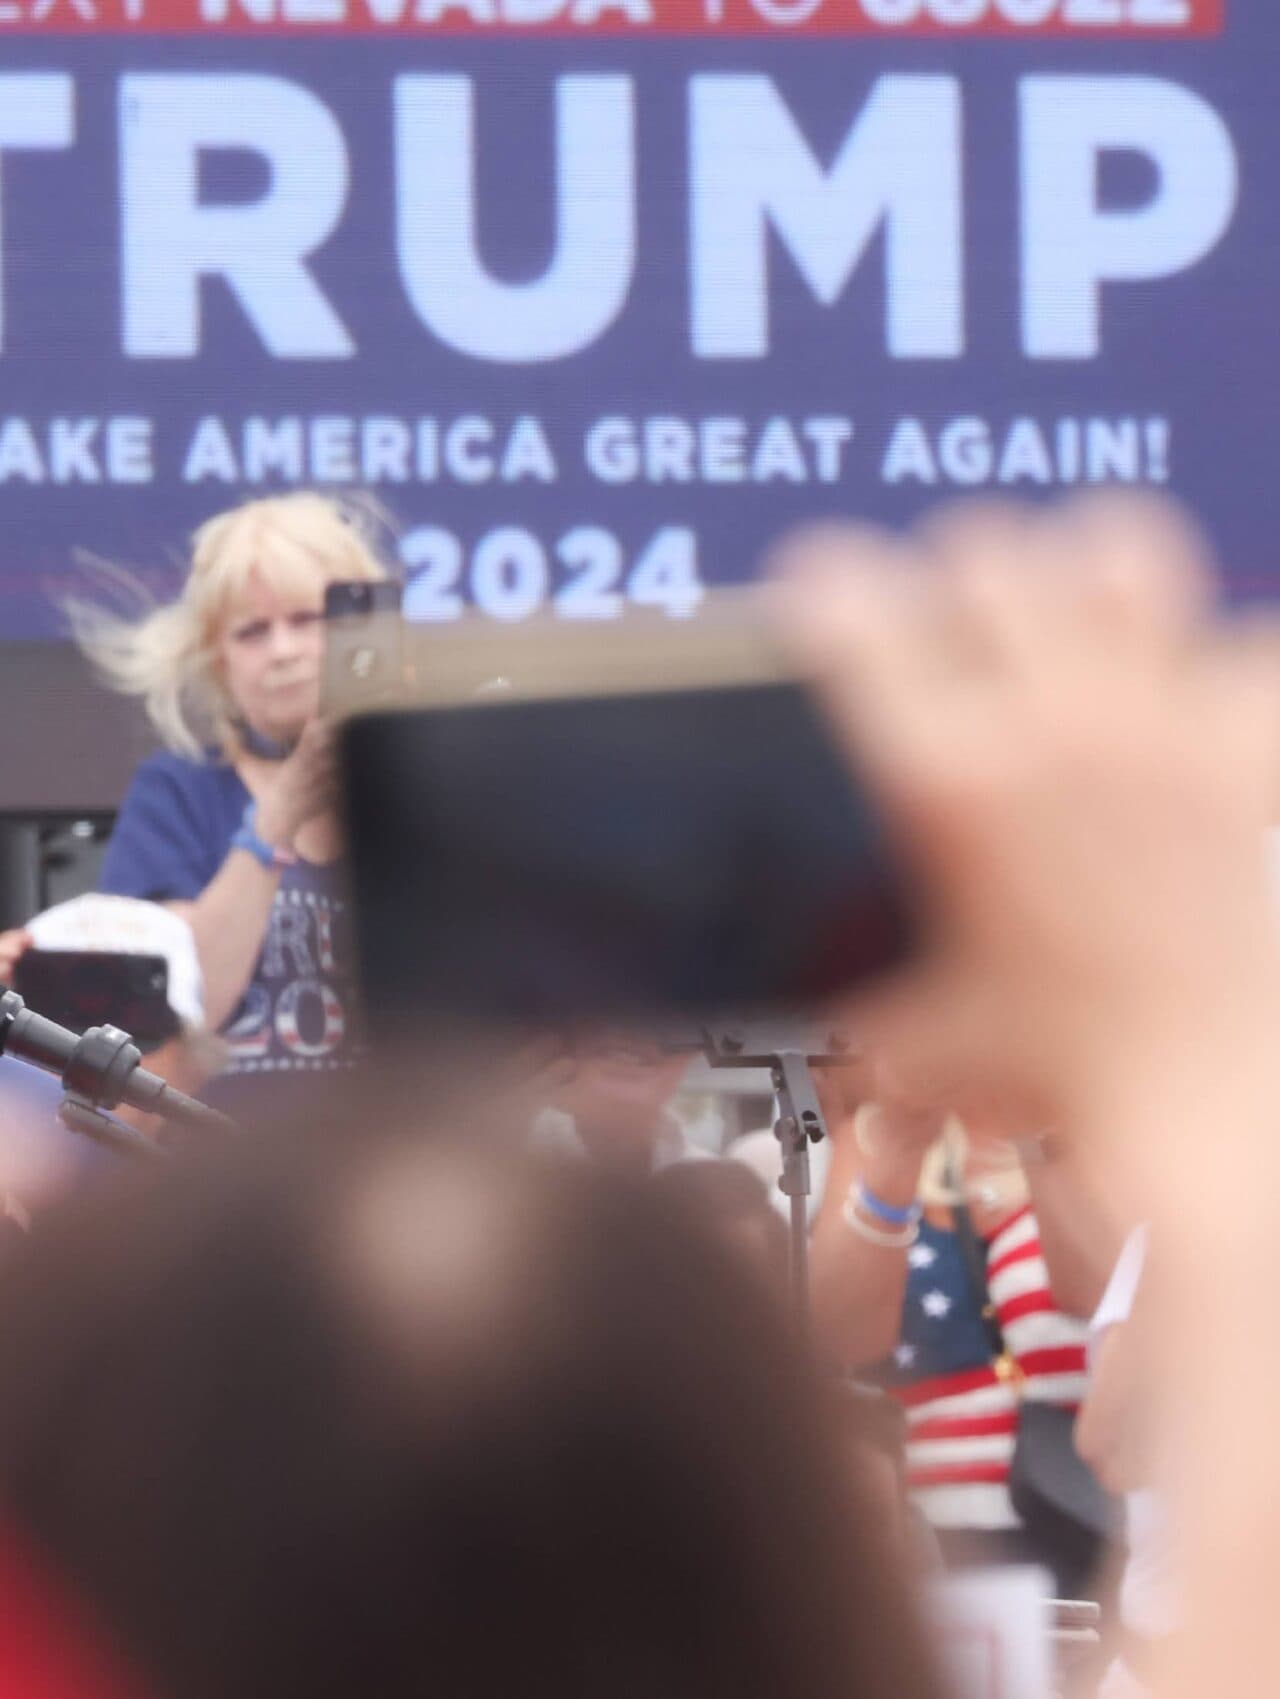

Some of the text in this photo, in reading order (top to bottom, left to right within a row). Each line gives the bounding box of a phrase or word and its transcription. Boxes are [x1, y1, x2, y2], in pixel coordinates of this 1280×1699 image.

[183, 416, 556, 482] AMERICA
[585, 416, 852, 483] GREAT
[882, 416, 1169, 483] AGAIN!
[400, 525, 704, 625] 2024
